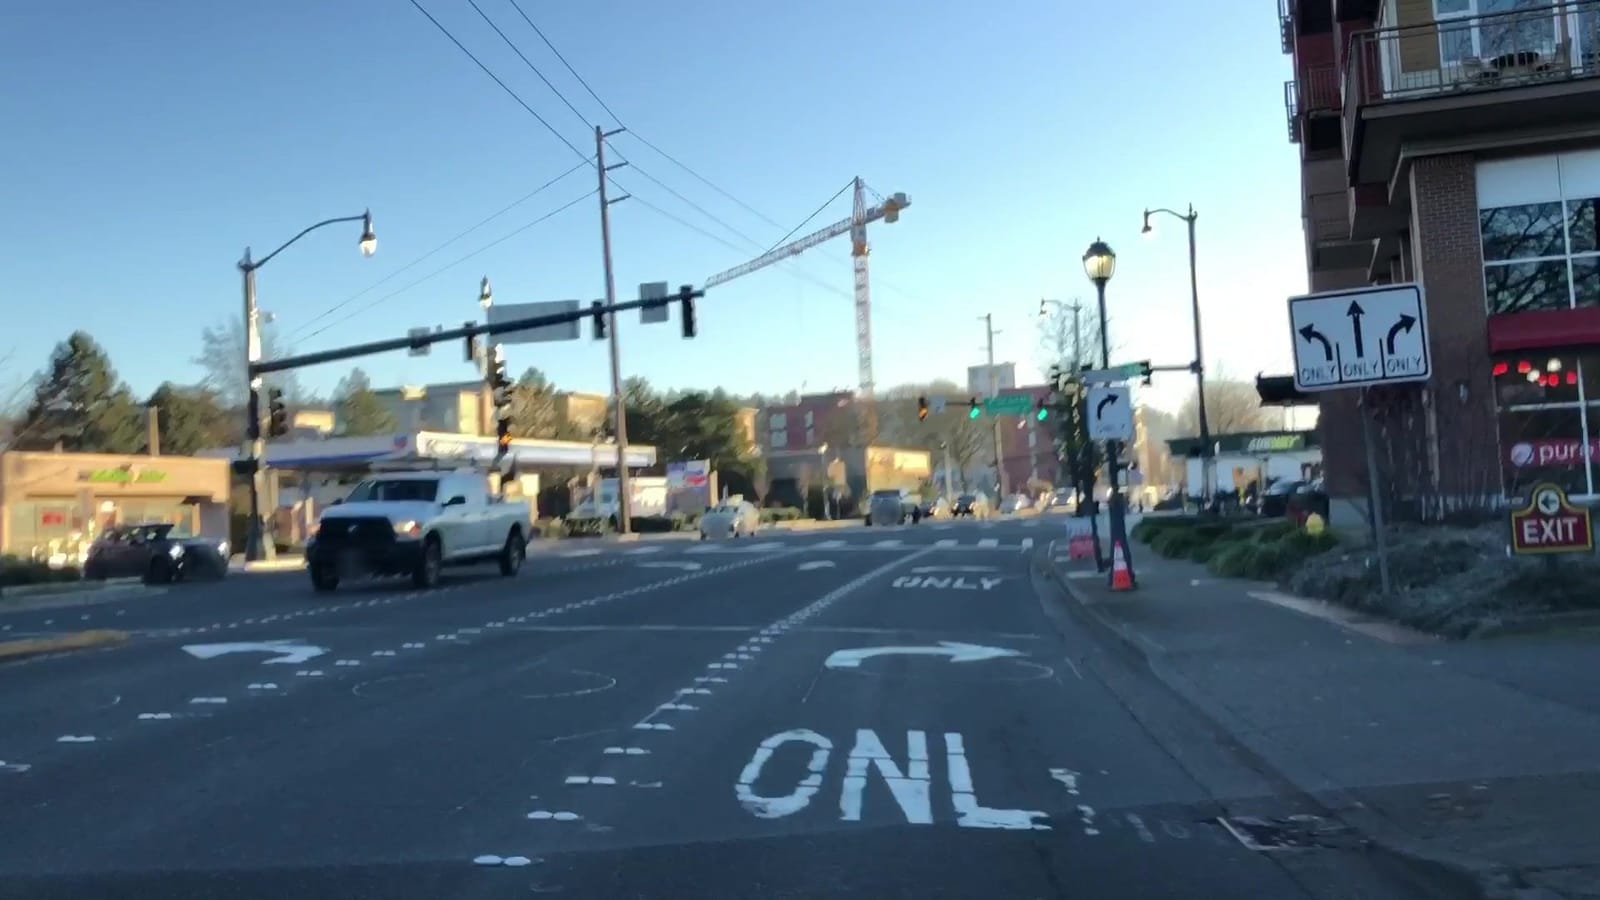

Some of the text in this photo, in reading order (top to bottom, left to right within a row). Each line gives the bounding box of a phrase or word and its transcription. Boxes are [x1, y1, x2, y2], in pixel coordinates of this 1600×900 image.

[1302, 355, 1421, 381] ONLY ONLY ONLY
[1523, 517, 1578, 544] EXIT
[892, 576, 1003, 590] ONLY
